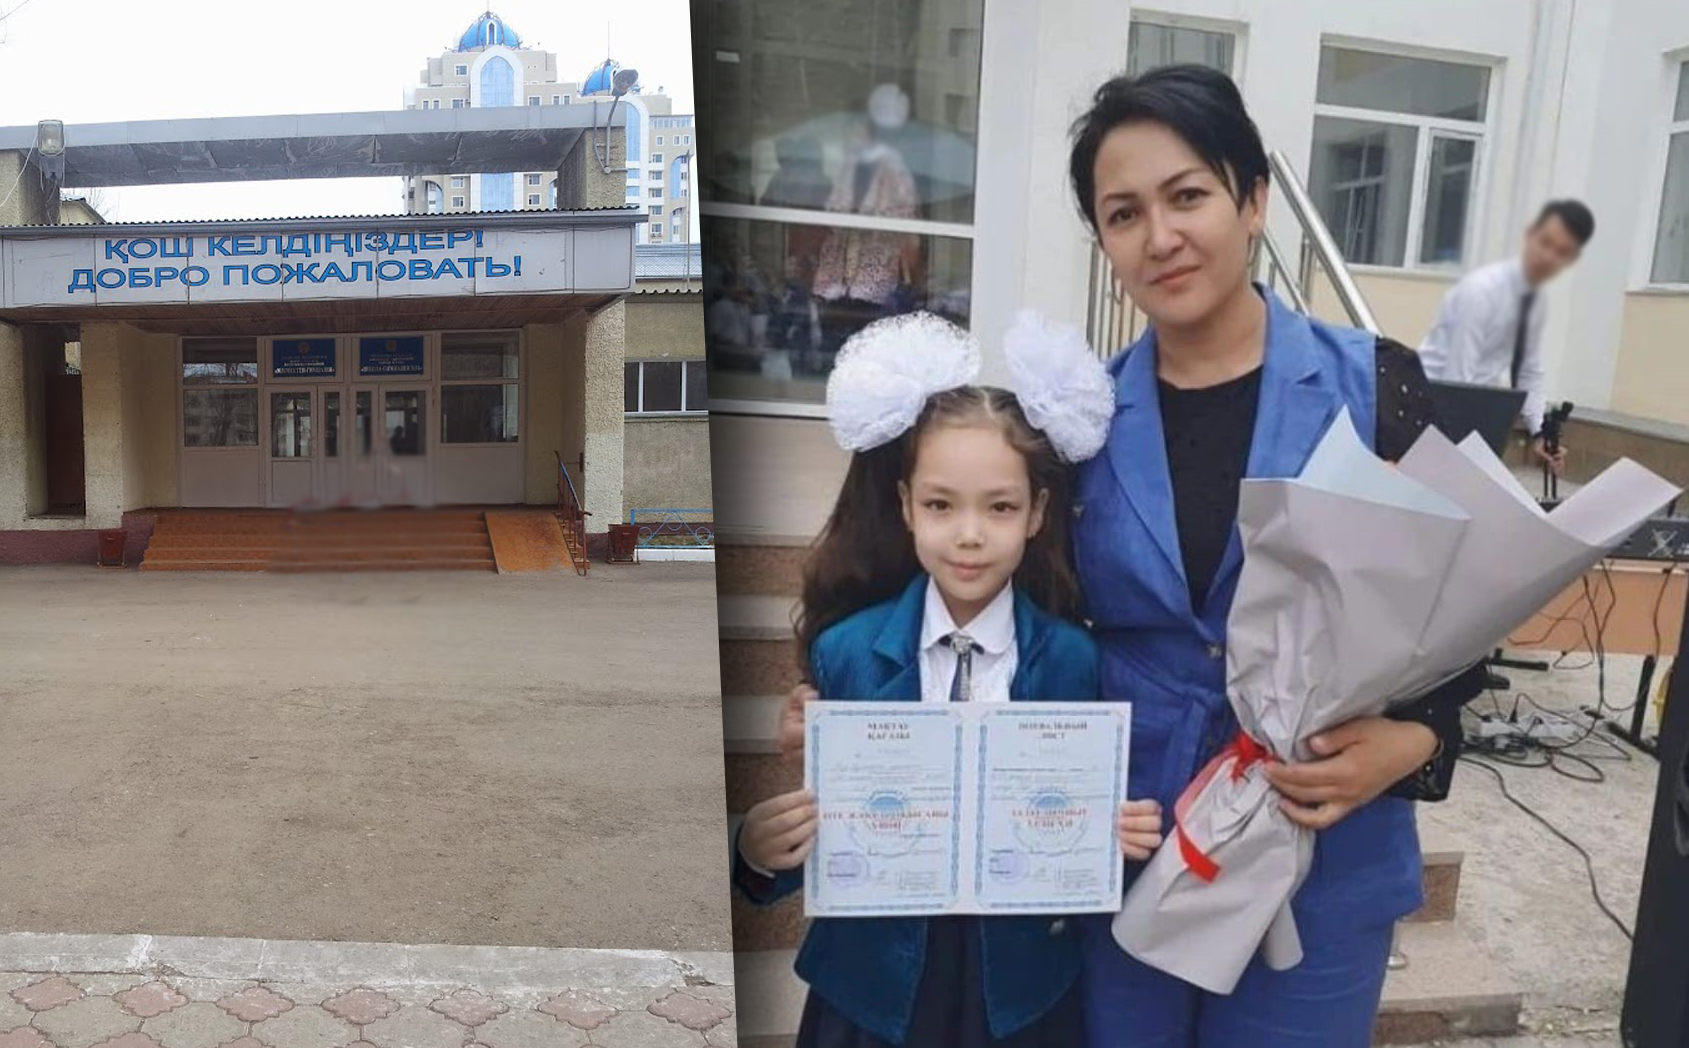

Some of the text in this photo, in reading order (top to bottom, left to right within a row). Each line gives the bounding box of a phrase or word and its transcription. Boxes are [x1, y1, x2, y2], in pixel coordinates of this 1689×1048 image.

[105, 230, 484, 263] ҚОШ КЕЛДІҢІЗДЕР!
[68, 255, 522, 294] ДОБРО ПОЖАЛОВАТЬ!
